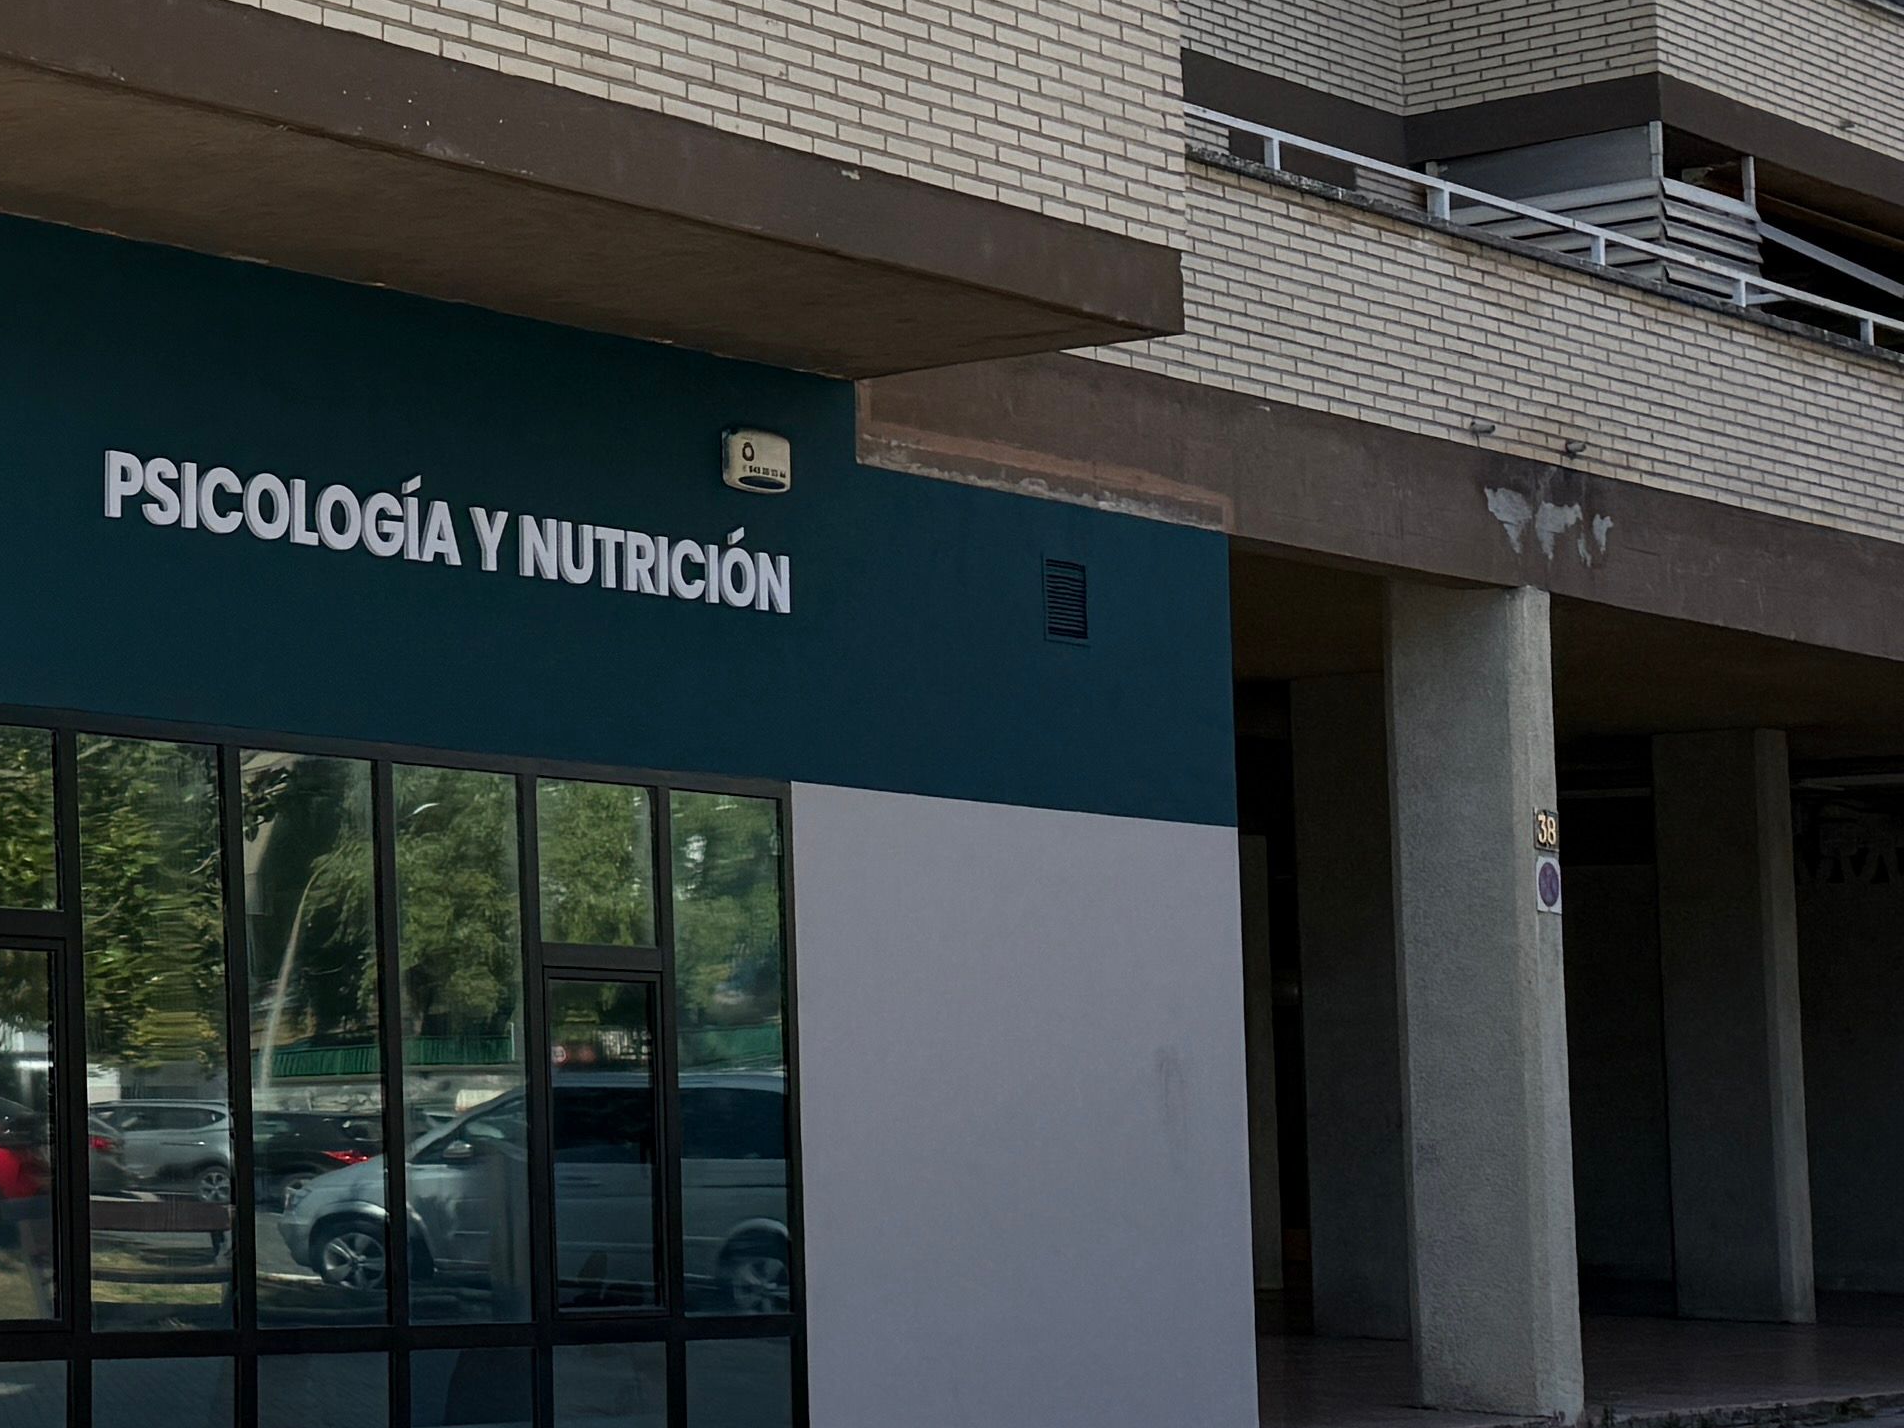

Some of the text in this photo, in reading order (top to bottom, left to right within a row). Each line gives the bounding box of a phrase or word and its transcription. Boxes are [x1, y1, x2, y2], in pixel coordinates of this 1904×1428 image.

[104, 450, 792, 614] PSICOLOGÍA Y NUTRICIÓN
[1536, 813, 1557, 846] 38
